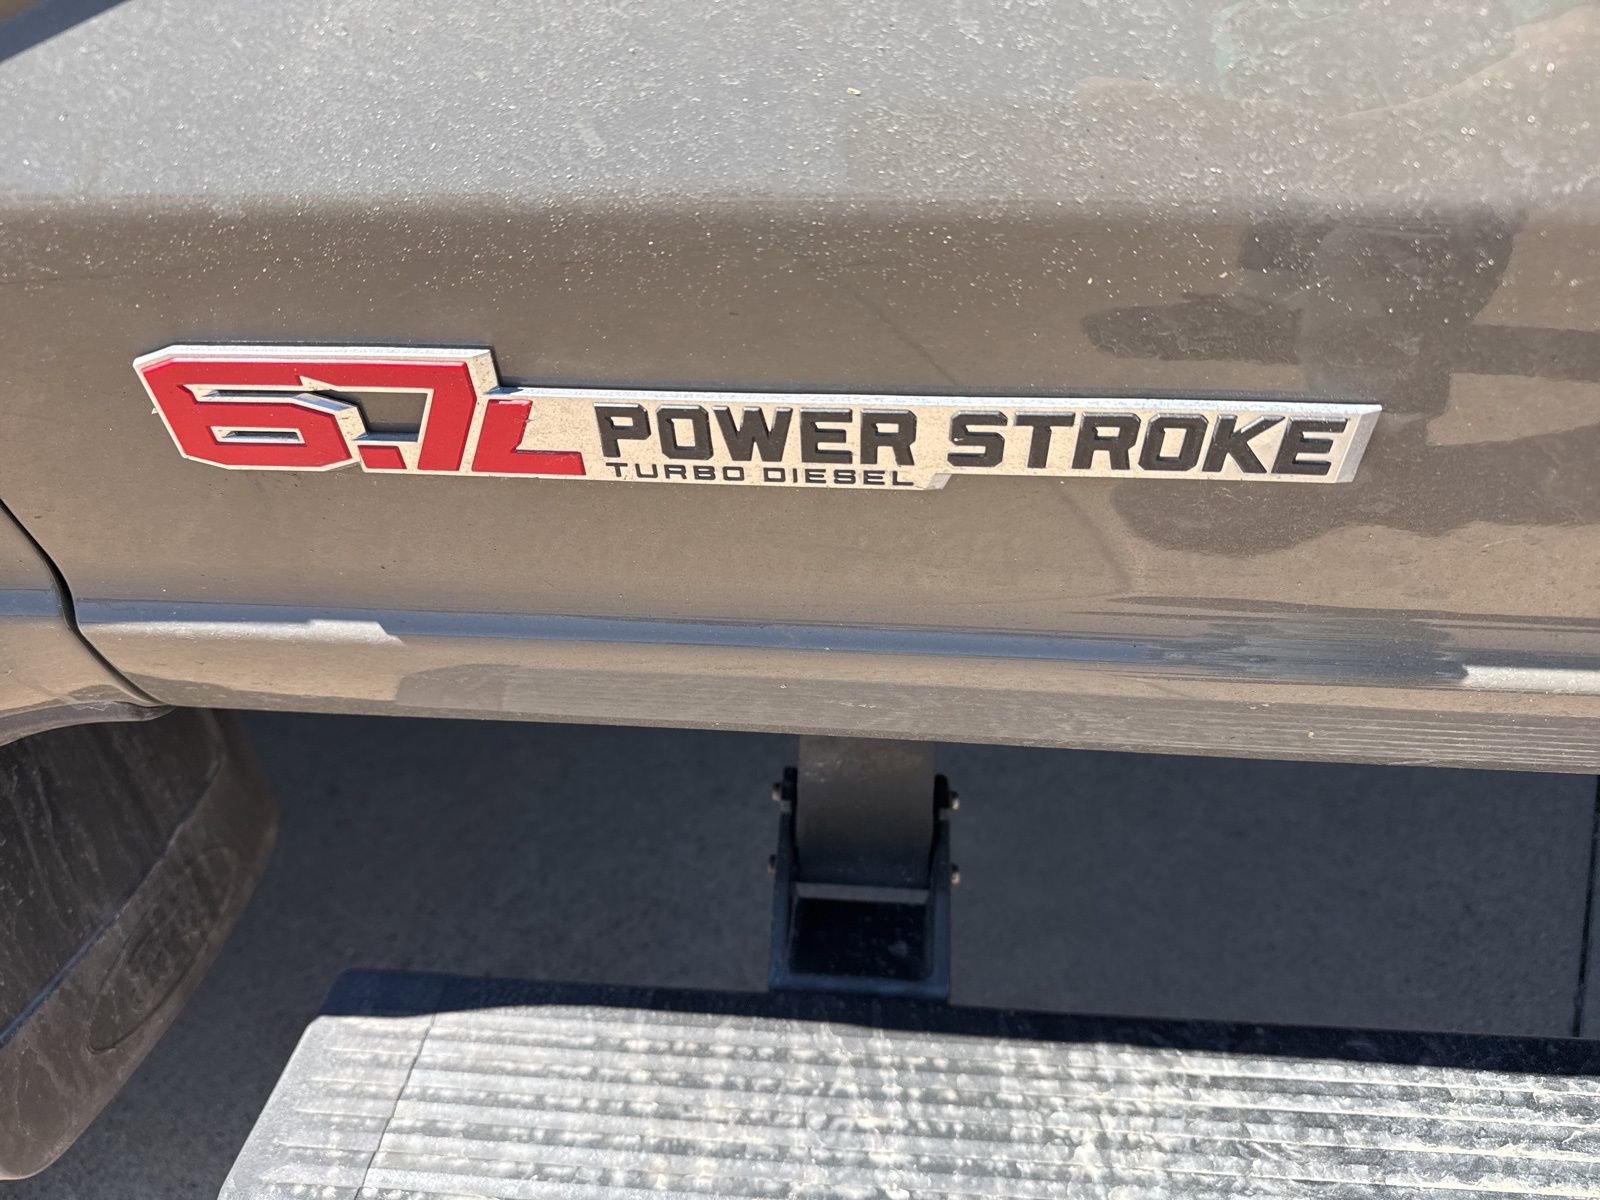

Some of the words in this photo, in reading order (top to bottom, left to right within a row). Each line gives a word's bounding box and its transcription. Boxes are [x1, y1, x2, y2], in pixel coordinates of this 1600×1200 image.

[141, 357, 587, 476] 6.7L
[594, 402, 918, 466] POWER
[947, 410, 1349, 476] STROKE
[605, 462, 745, 482] TURBO
[762, 467, 915, 487] DIESEL
